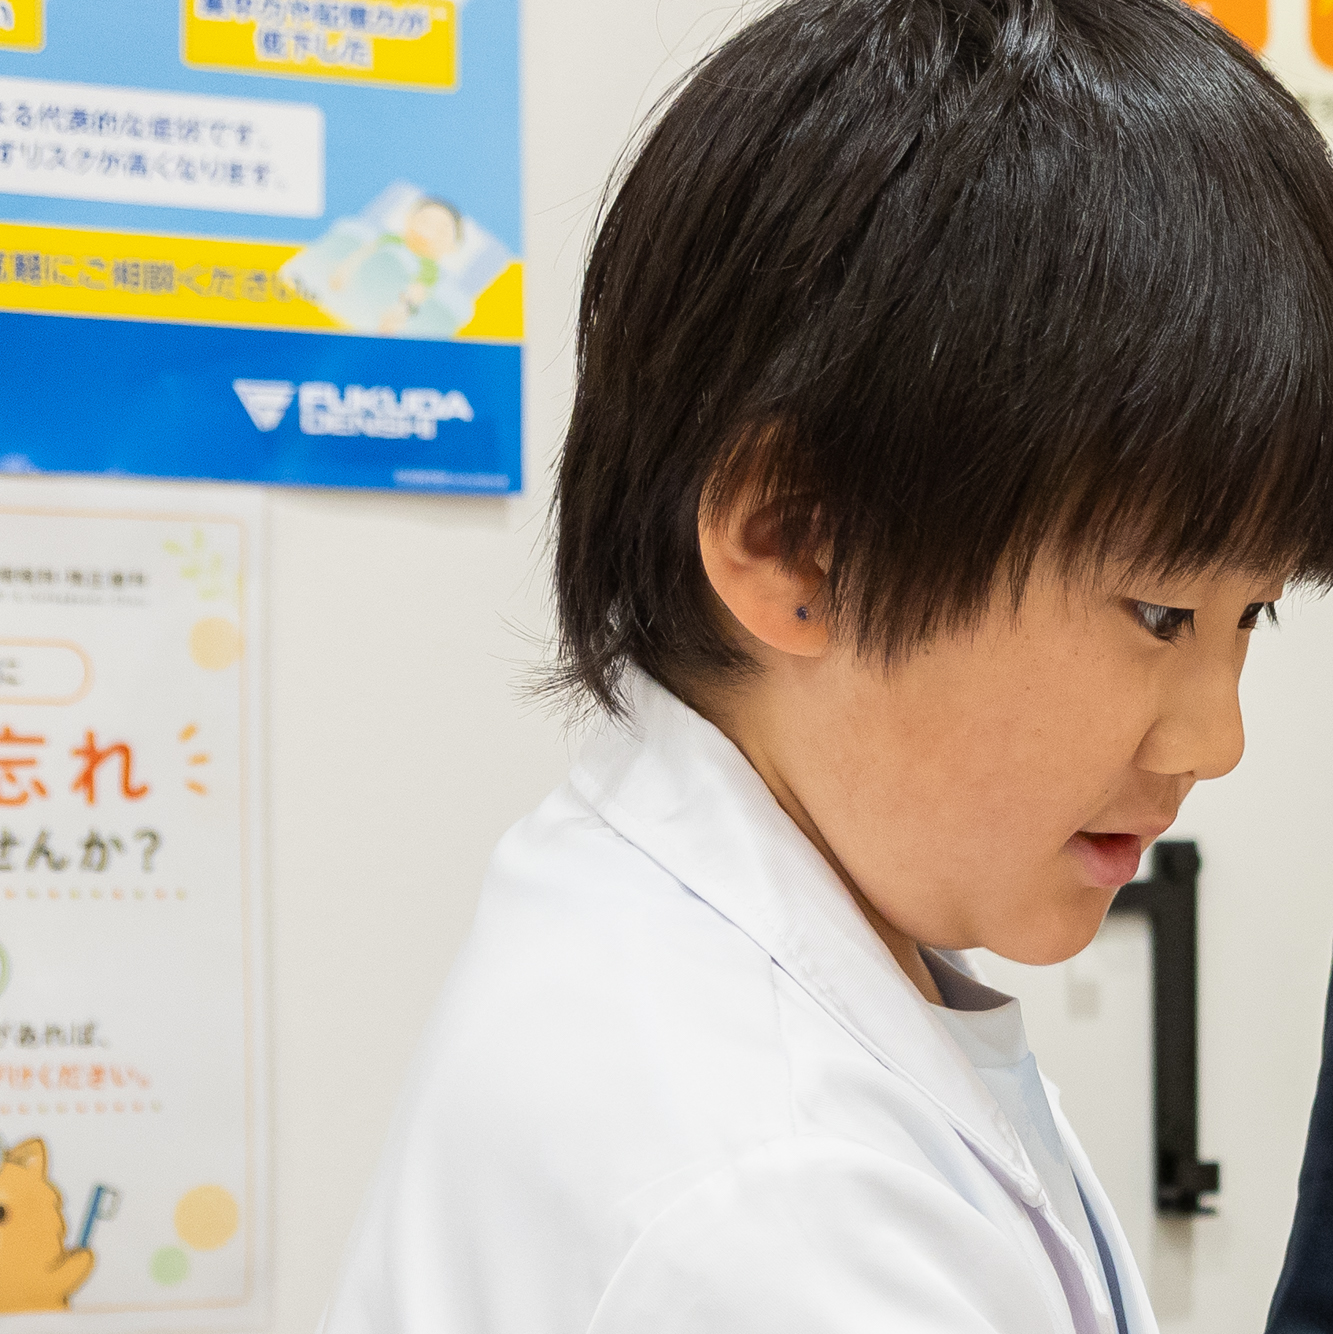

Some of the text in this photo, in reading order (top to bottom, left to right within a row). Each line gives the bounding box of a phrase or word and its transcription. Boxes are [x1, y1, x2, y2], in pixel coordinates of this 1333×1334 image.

[0, 101, 271, 151] る代表的な症状です。
